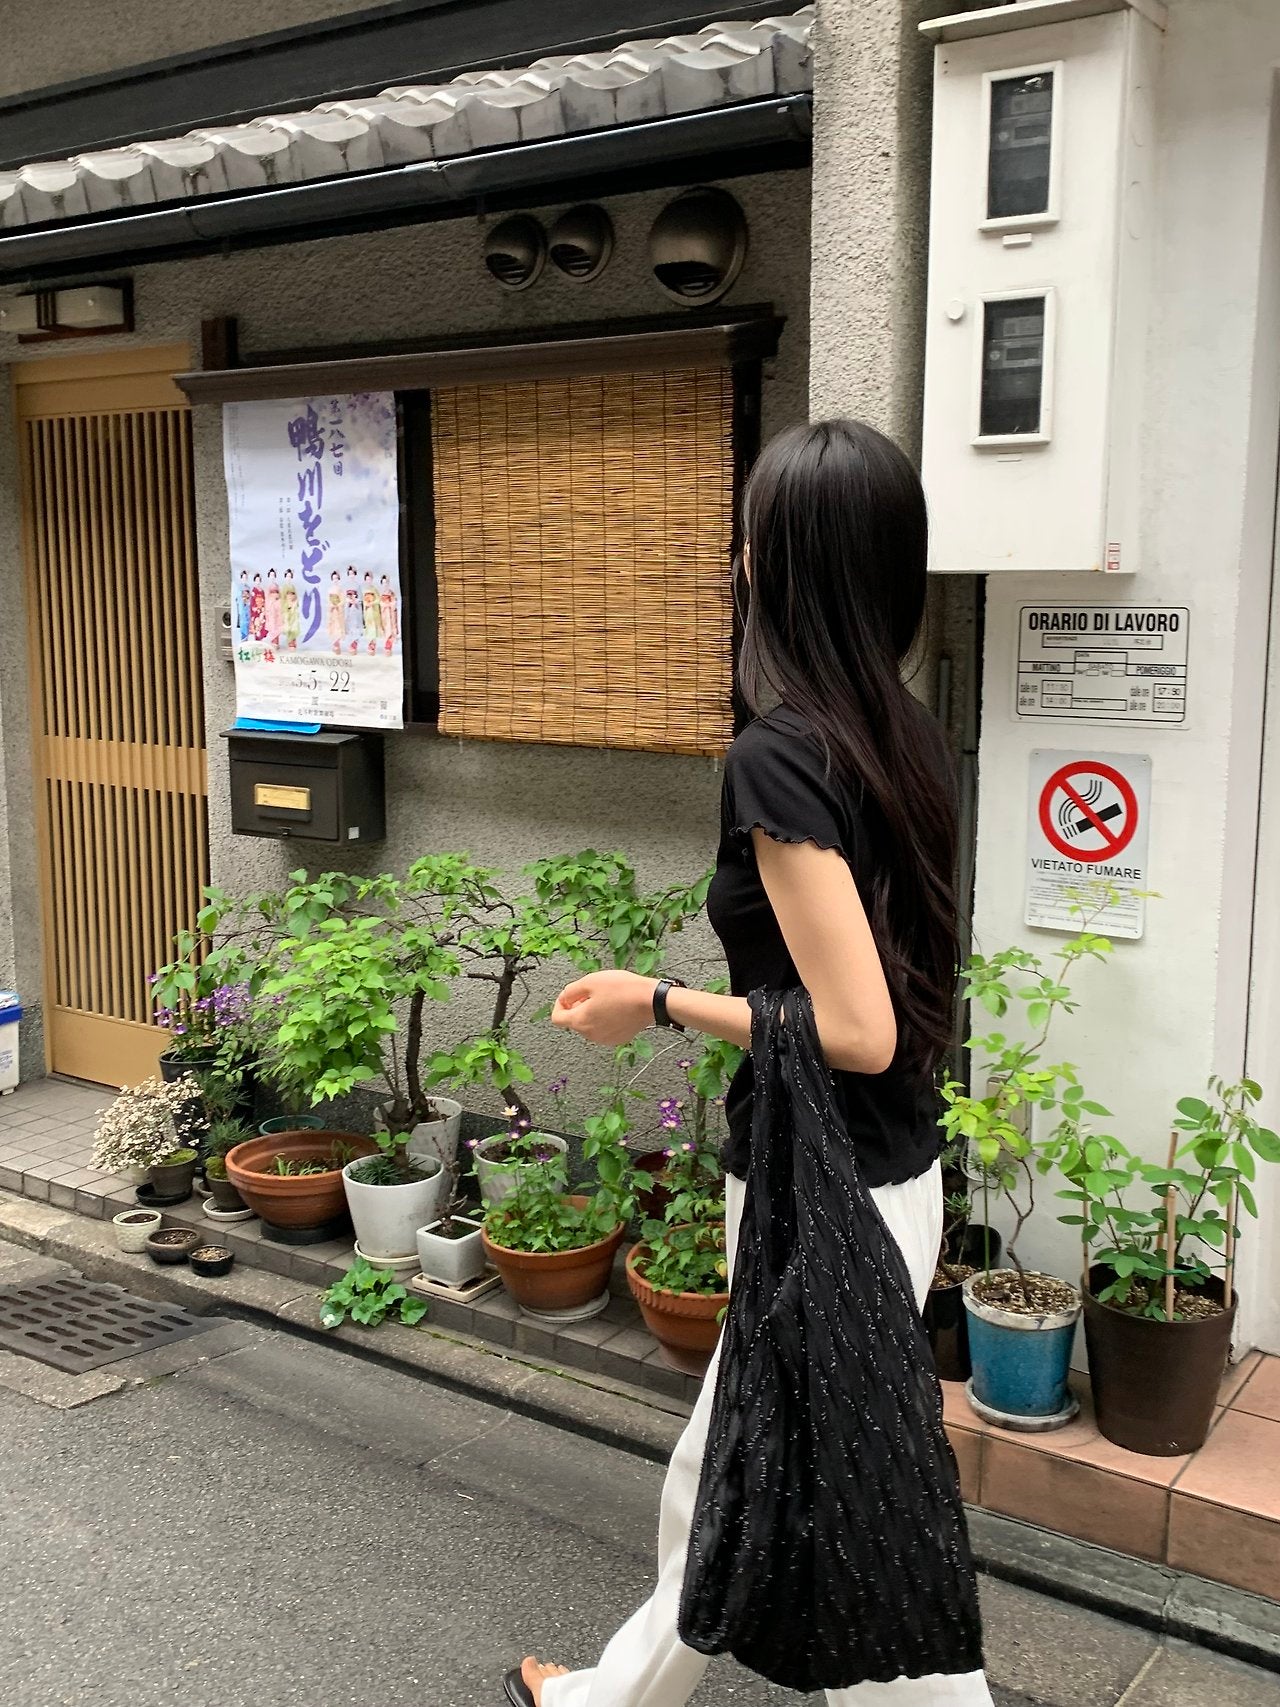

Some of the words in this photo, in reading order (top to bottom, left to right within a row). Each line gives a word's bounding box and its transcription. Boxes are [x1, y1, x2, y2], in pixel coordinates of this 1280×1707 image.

[287, 403, 331, 645] 鴨川をどり
[1029, 612, 1088, 631] ORARIO
[1094, 613, 1109, 631] DI
[1115, 613, 1180, 632] LAVORO
[279, 656, 326, 666] KAMOGAWA
[326, 658, 353, 668] ODORI
[1136, 665, 1176, 675] POMERIGGIO
[1031, 858, 1083, 873] VIETATO
[1086, 864, 1142, 880] FUMARE
